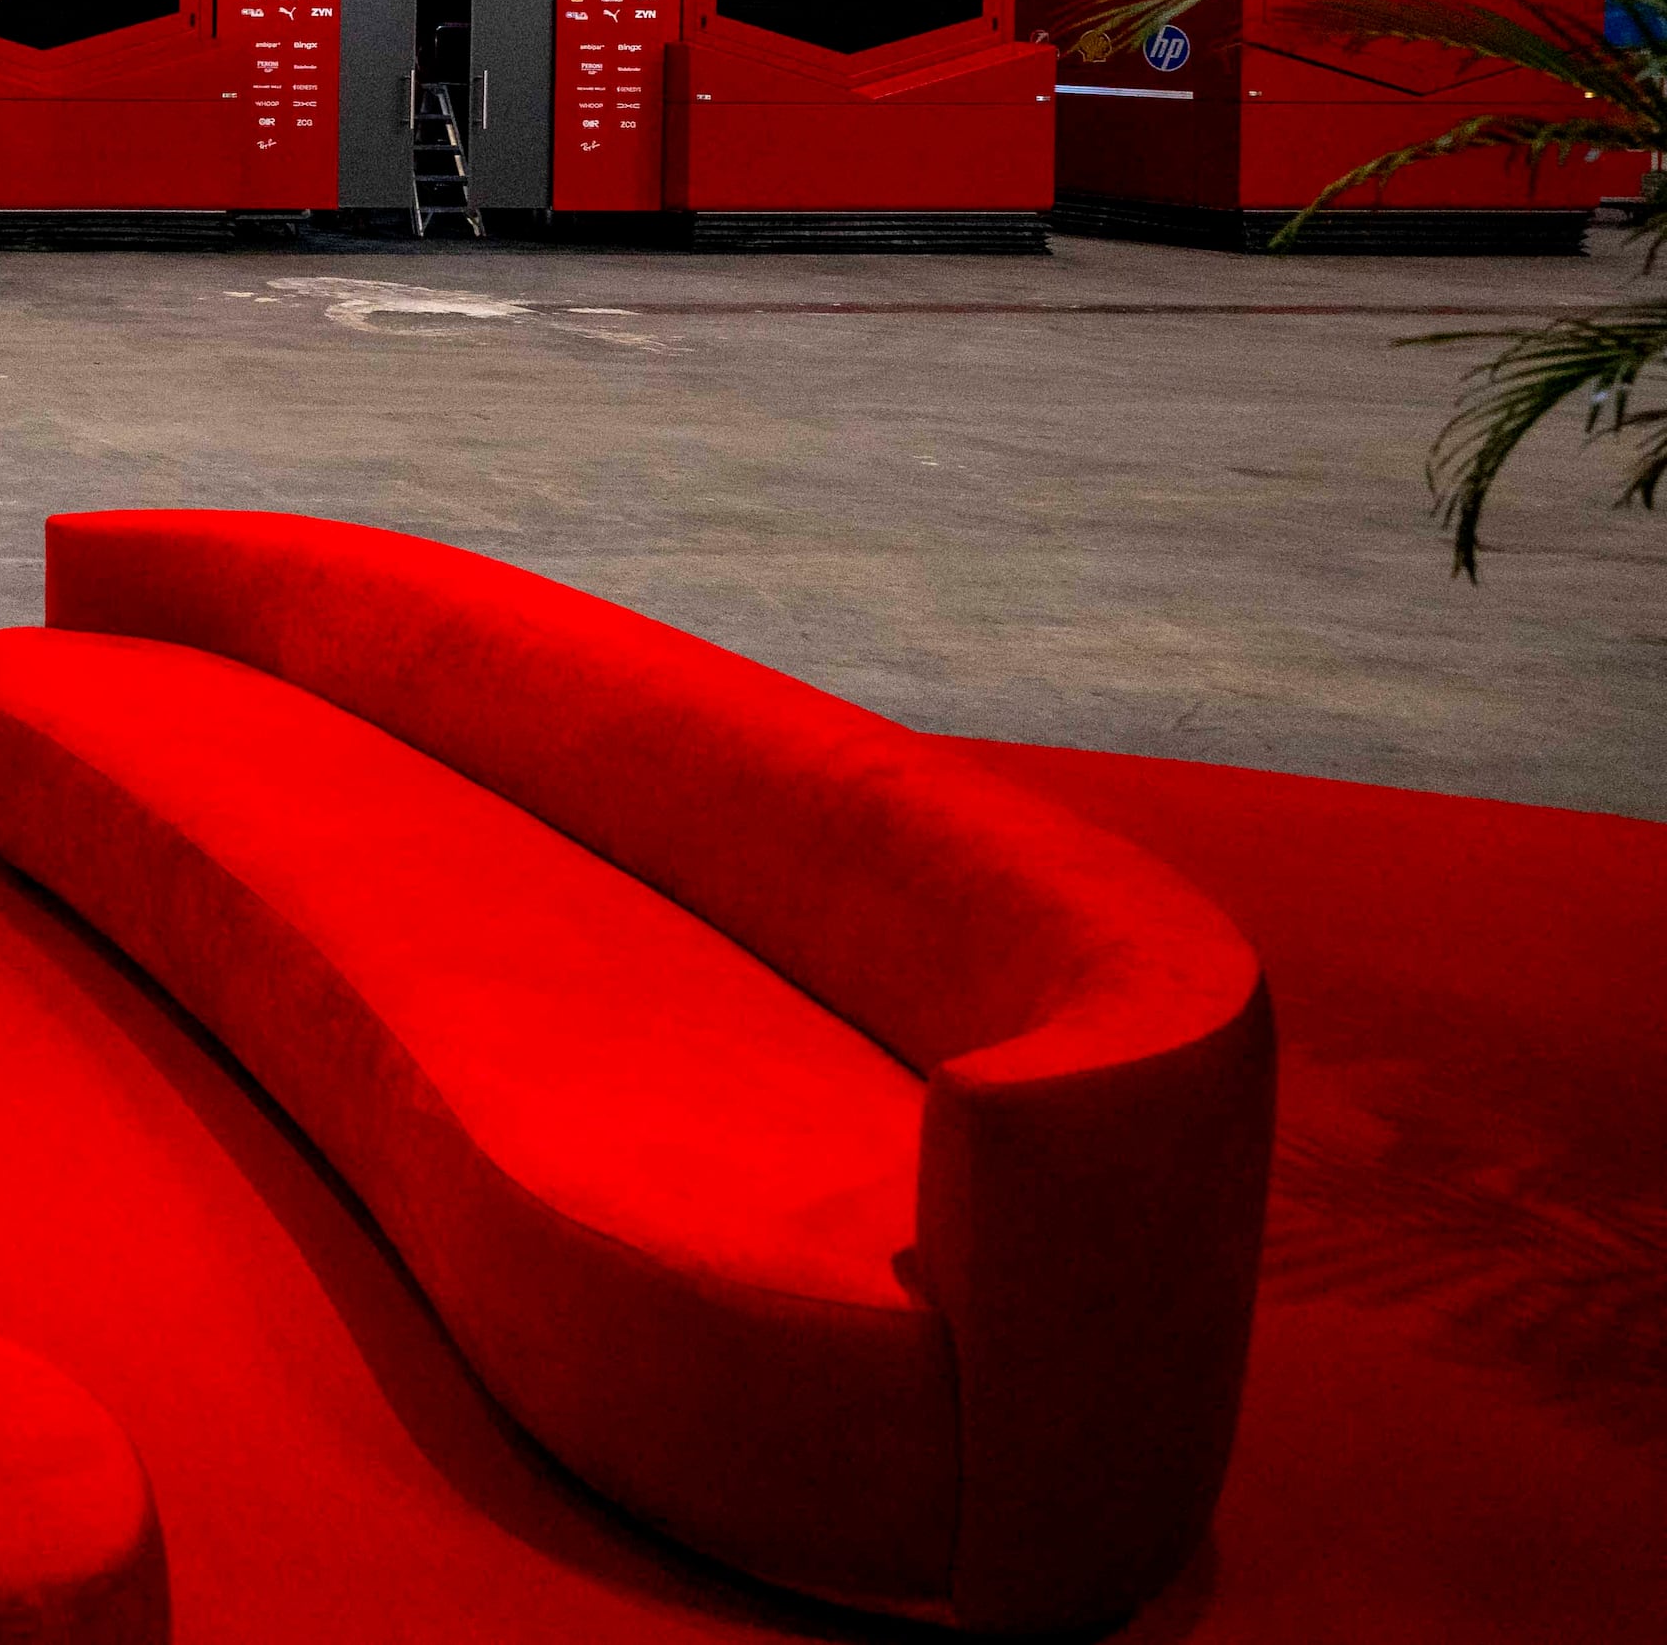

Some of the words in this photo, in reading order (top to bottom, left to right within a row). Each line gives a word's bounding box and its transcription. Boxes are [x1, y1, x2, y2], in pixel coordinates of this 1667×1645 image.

[310, 8, 333, 16] ZYN
[634, 10, 657, 18] ZYN
[1149, 25, 1185, 70] hp
